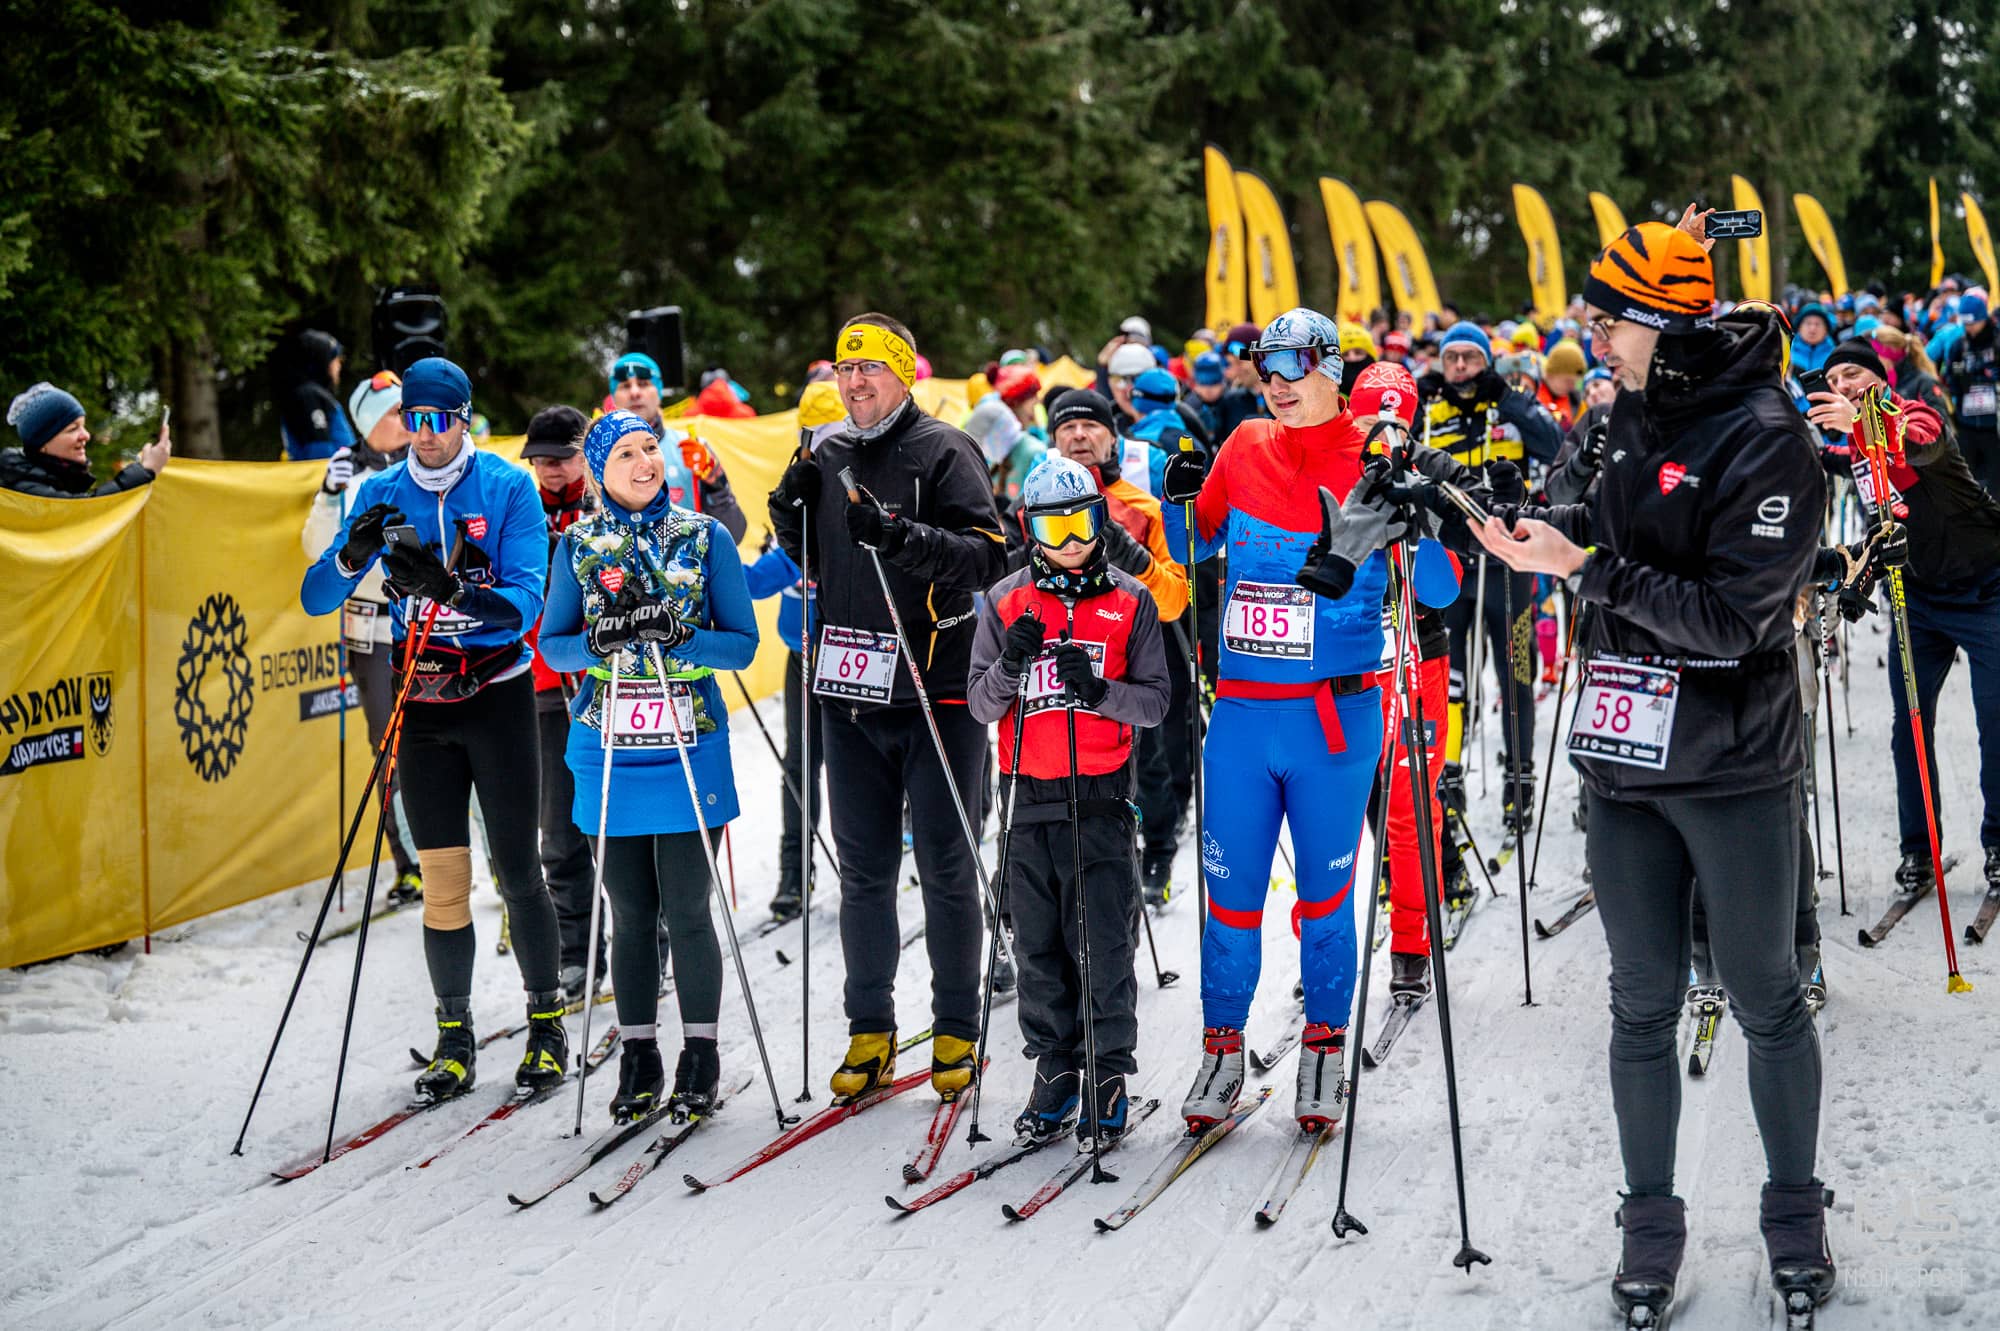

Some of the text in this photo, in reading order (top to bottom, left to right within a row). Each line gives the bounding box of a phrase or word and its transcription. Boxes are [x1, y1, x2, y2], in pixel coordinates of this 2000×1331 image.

[1241, 604, 1289, 638] 185
[838, 650, 869, 681] 69
[630, 702, 664, 730] 67
[1592, 692, 1633, 734] 58
